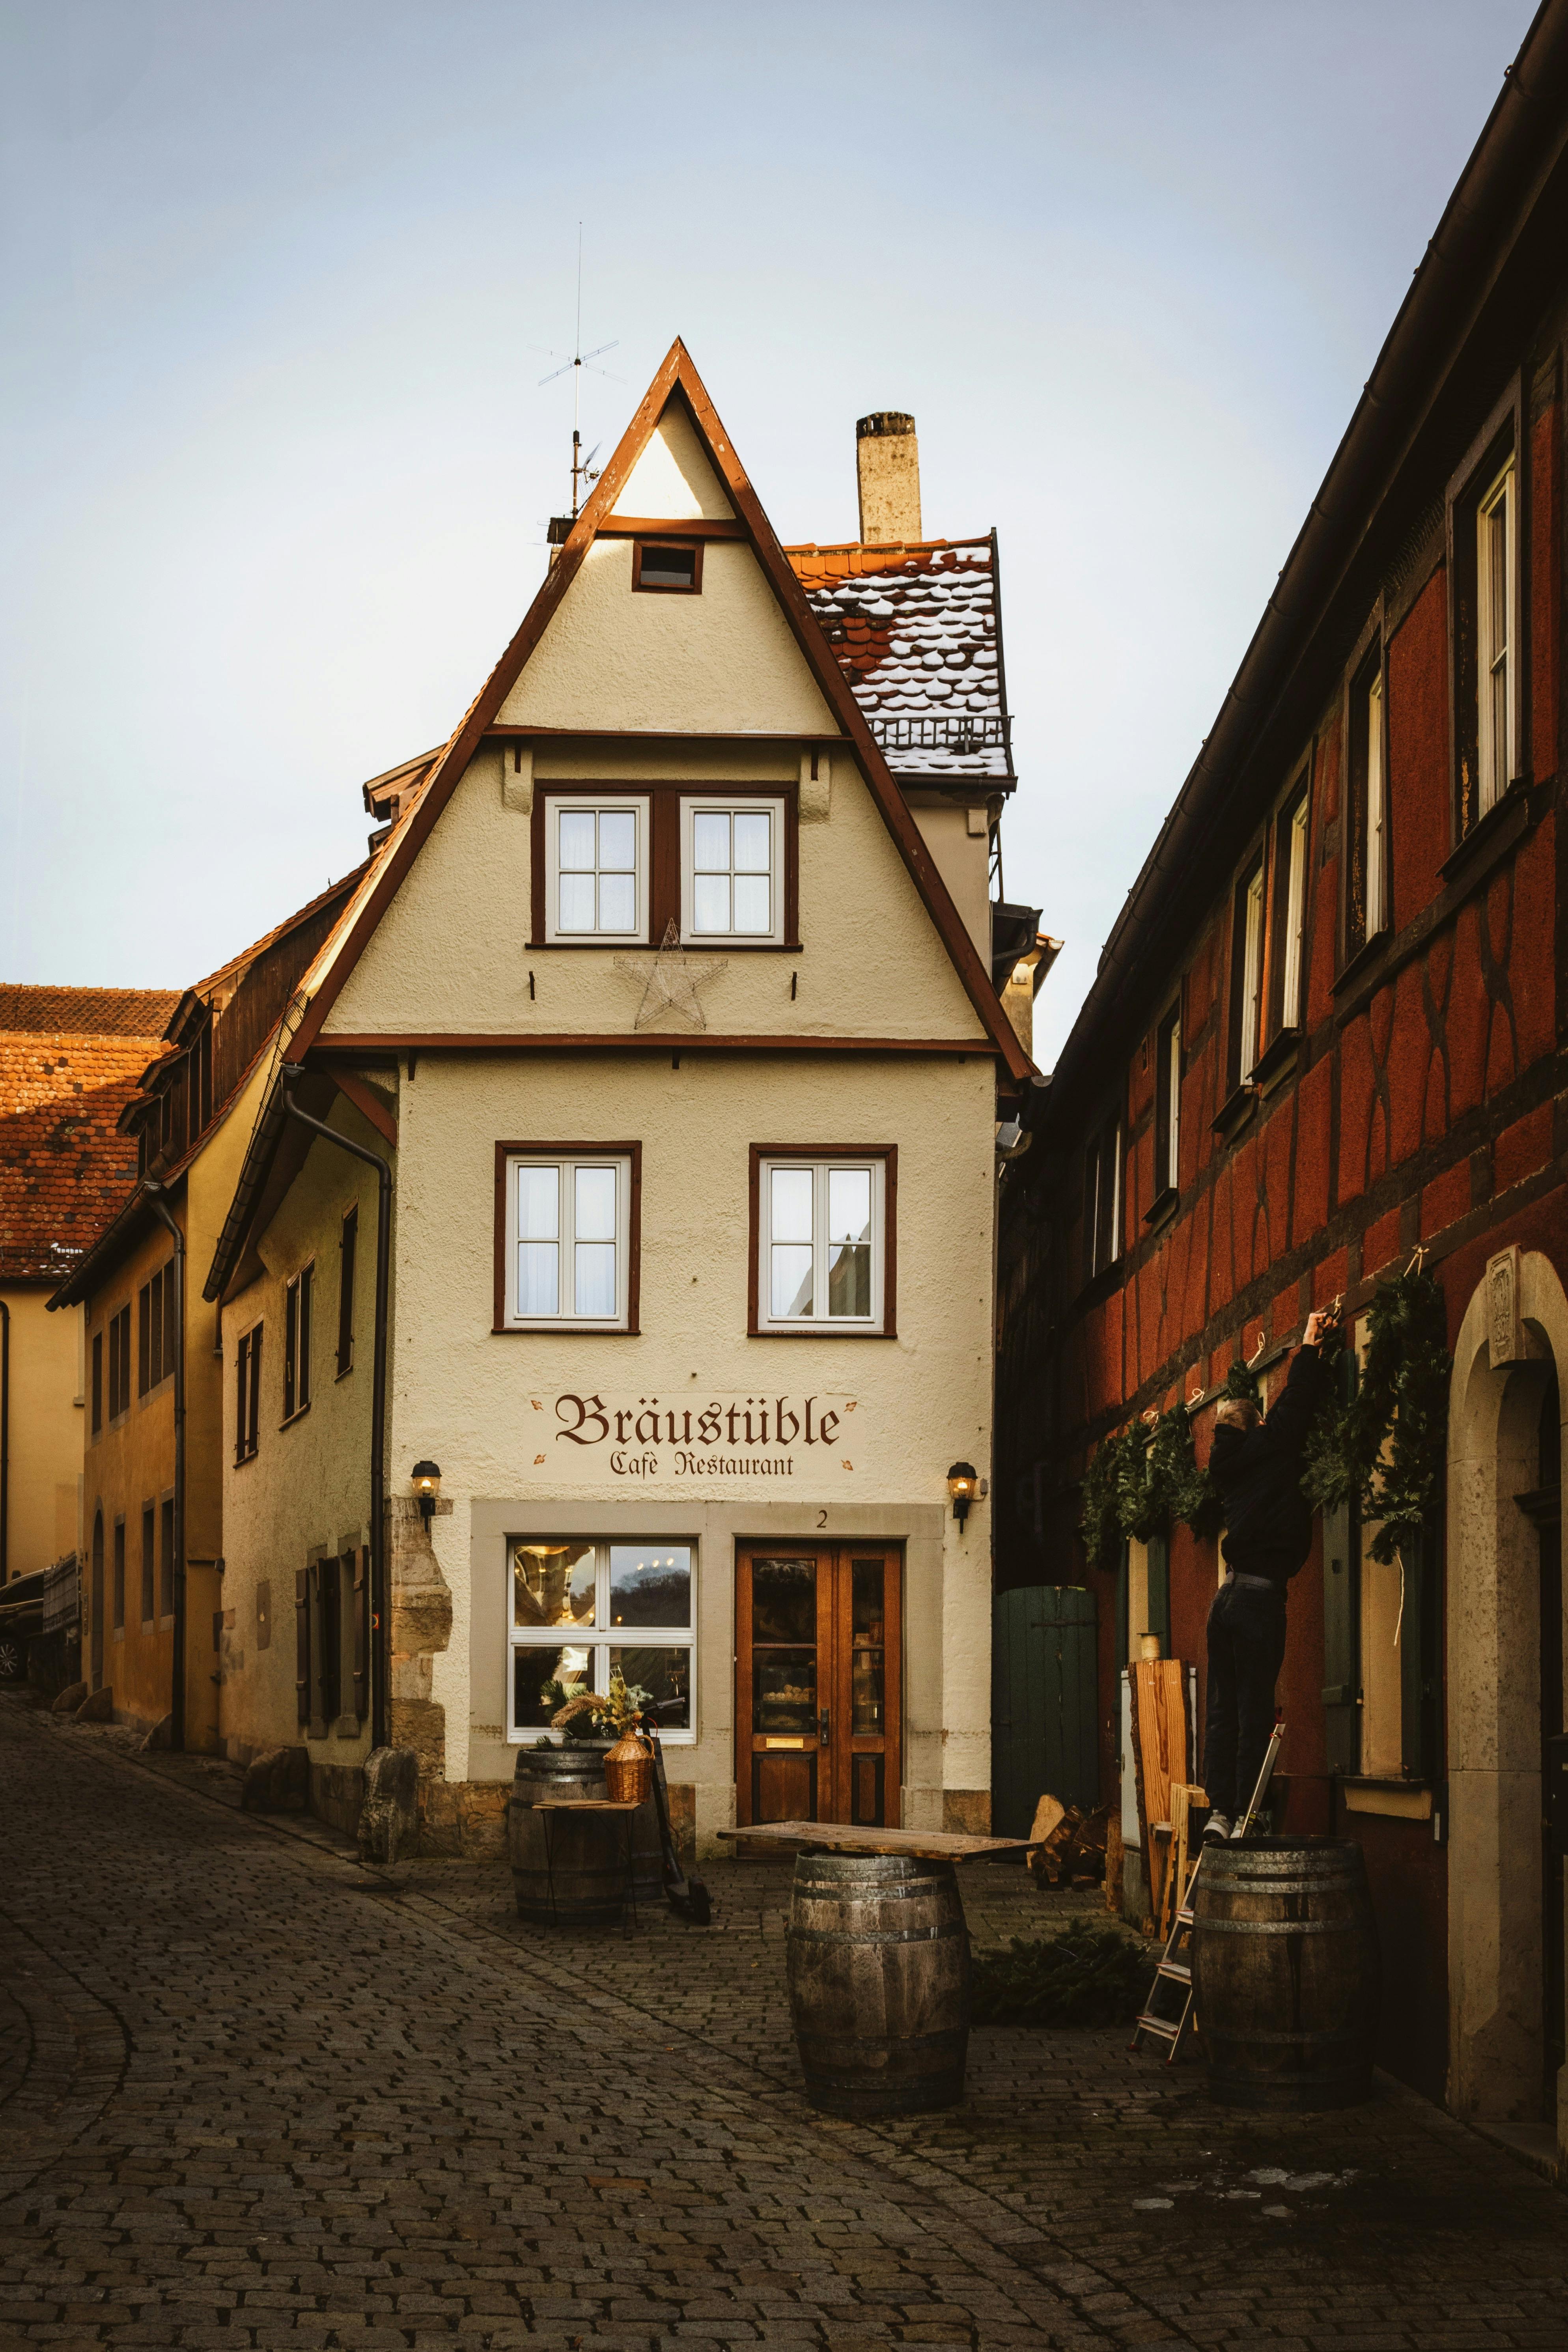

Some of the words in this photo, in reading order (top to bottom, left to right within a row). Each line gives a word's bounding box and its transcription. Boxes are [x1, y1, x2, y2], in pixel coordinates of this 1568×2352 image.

[555, 1394, 840, 1446] Bräustüble
[674, 1451, 793, 1475] Restaurant
[816, 1509, 828, 1529] 2
